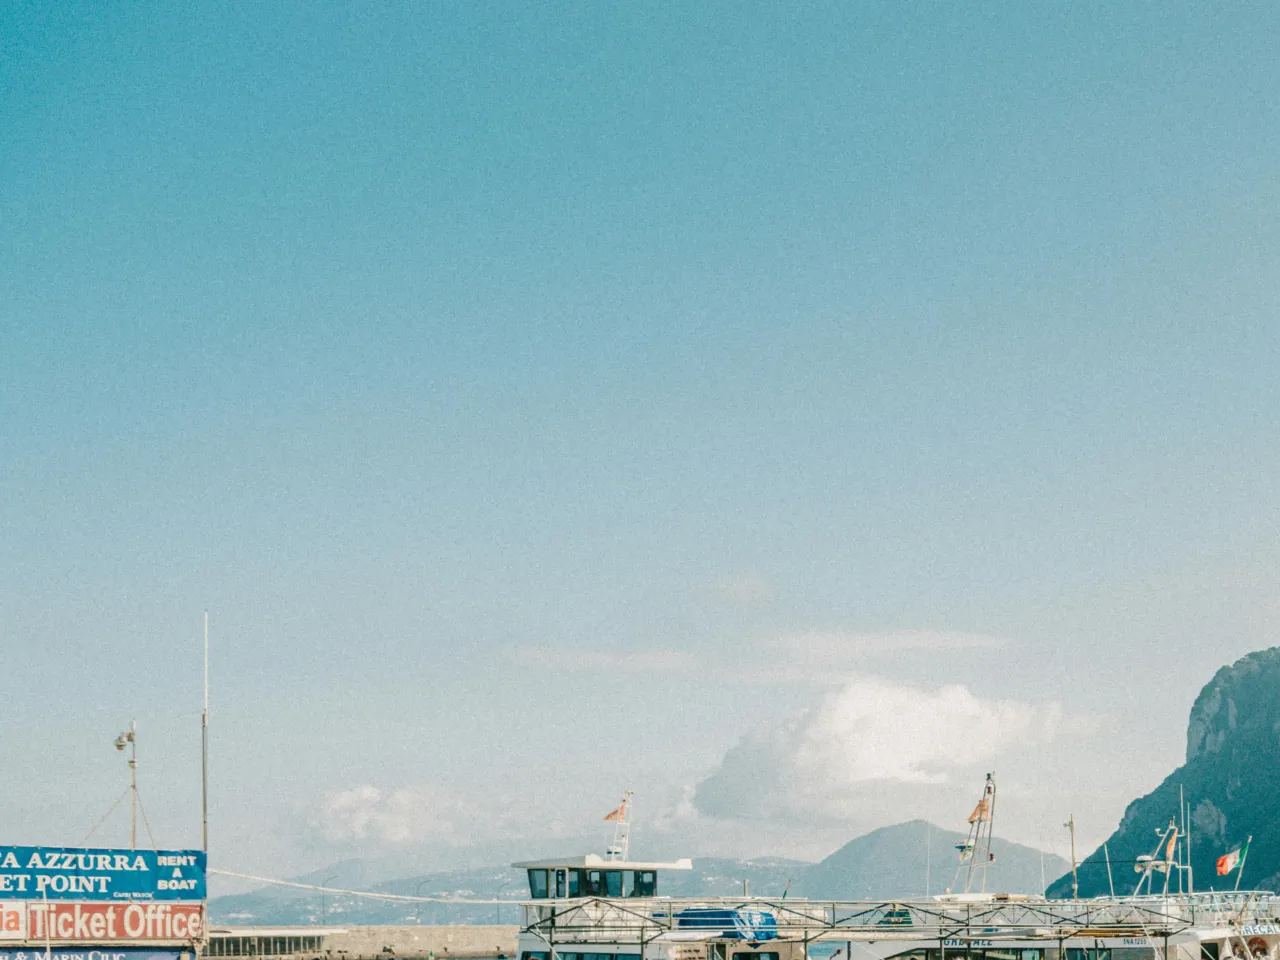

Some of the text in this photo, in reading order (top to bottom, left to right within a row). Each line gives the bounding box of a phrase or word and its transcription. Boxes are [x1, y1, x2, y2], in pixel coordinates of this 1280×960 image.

[26, 852, 149, 871] AZZURRA
[157, 855, 197, 866] RENT
[172, 867, 183, 878] A
[35, 875, 112, 893] POINT
[157, 879, 198, 890] BOAT
[29, 903, 117, 938] Ticket
[123, 904, 202, 938] Office
